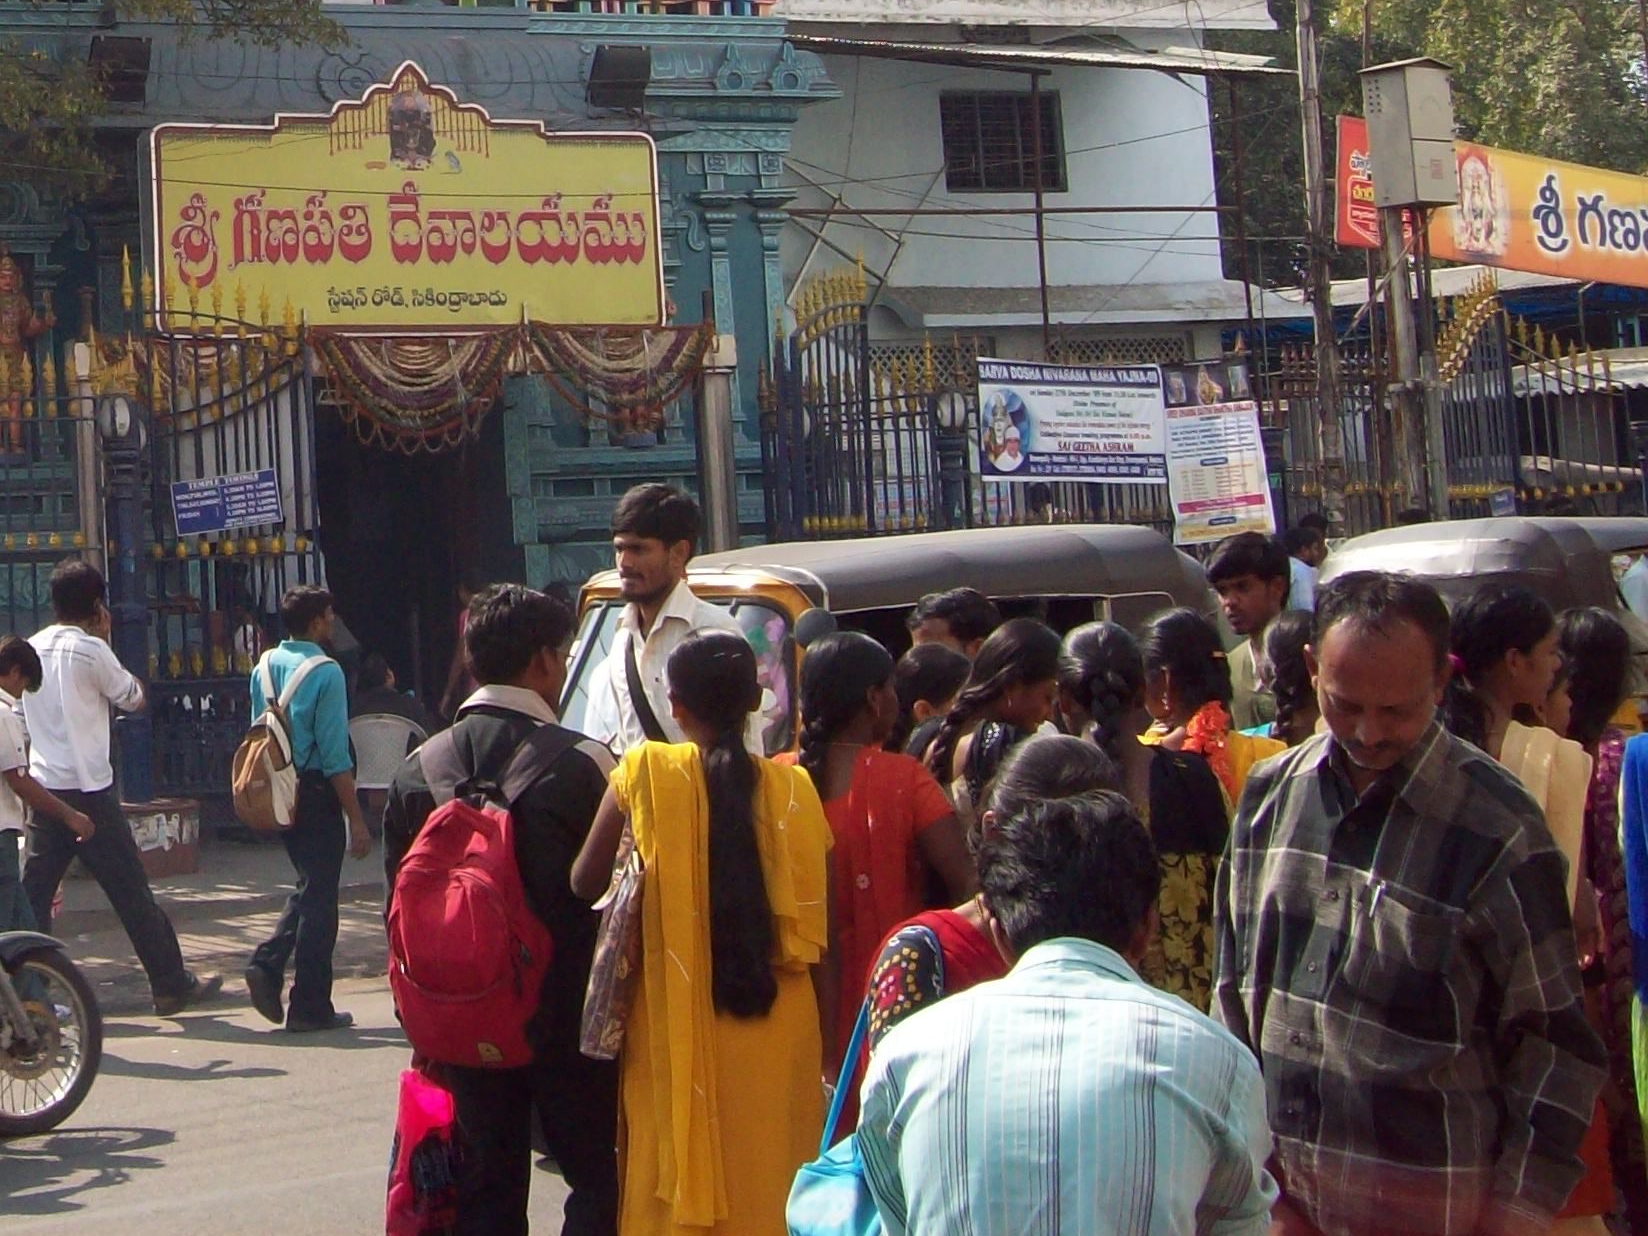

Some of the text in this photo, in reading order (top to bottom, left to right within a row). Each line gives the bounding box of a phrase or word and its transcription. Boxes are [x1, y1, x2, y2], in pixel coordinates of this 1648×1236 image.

[171, 179, 647, 289] శ్రీ గణపతి దేవాలయము
[1532, 173, 1569, 253] శ్రీ
[1057, 440, 1071, 452] SAI
[1102, 441, 1134, 453] ASHRAM
[188, 477, 220, 491] TEMPLE
